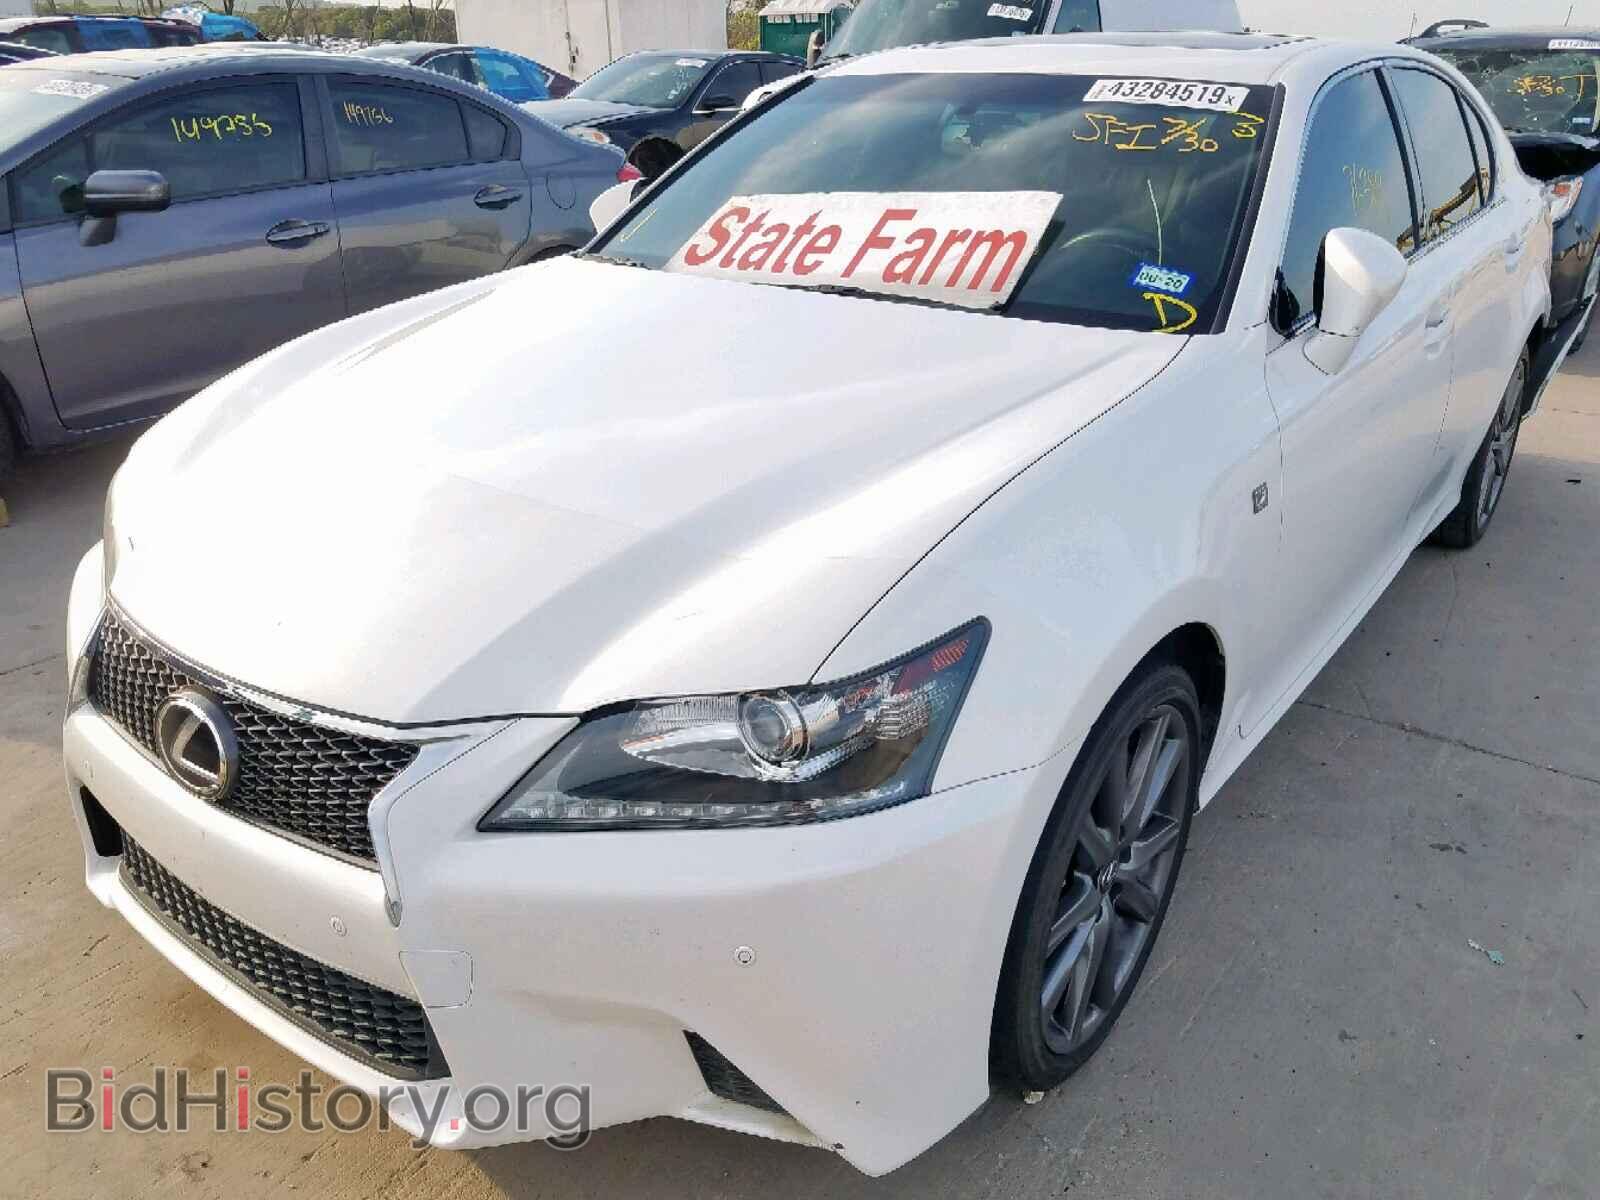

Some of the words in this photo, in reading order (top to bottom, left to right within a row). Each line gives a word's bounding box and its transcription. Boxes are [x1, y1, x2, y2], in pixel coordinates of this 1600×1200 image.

[1108, 80, 1227, 105] 43284519
[684, 206, 842, 276] State
[840, 208, 1027, 293] Farm
[1142, 292, 1198, 333] D
